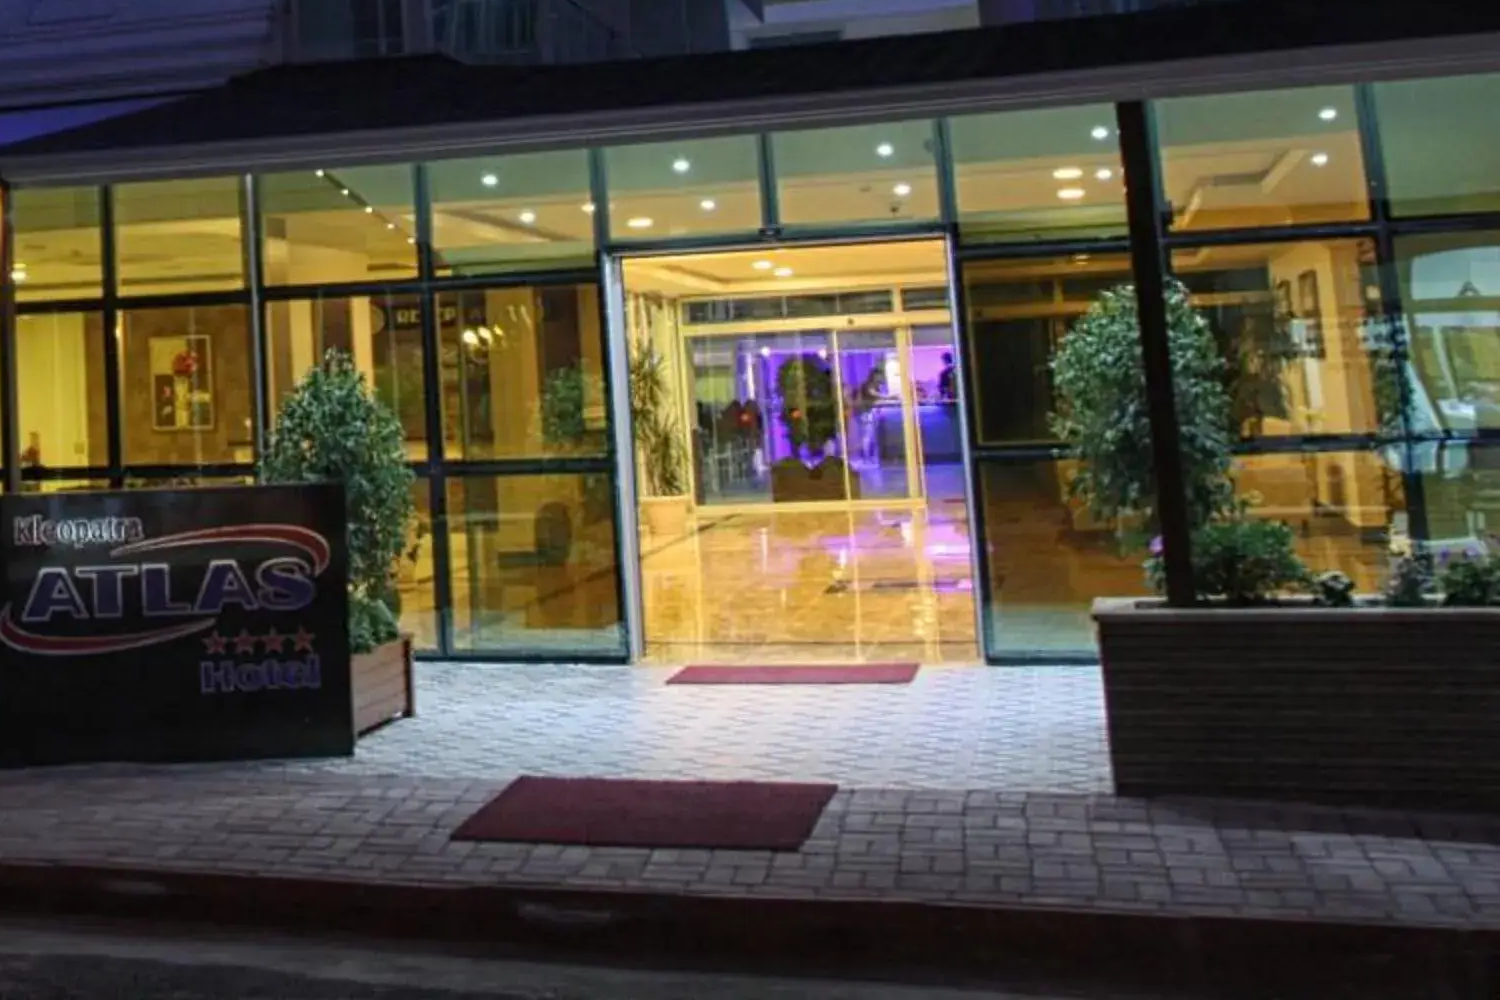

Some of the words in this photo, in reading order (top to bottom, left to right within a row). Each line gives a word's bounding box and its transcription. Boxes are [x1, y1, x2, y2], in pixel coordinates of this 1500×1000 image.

[13, 515, 144, 548] Kleopatra
[21, 557, 316, 621] ATLAS
[200, 654, 321, 693] Hotel
